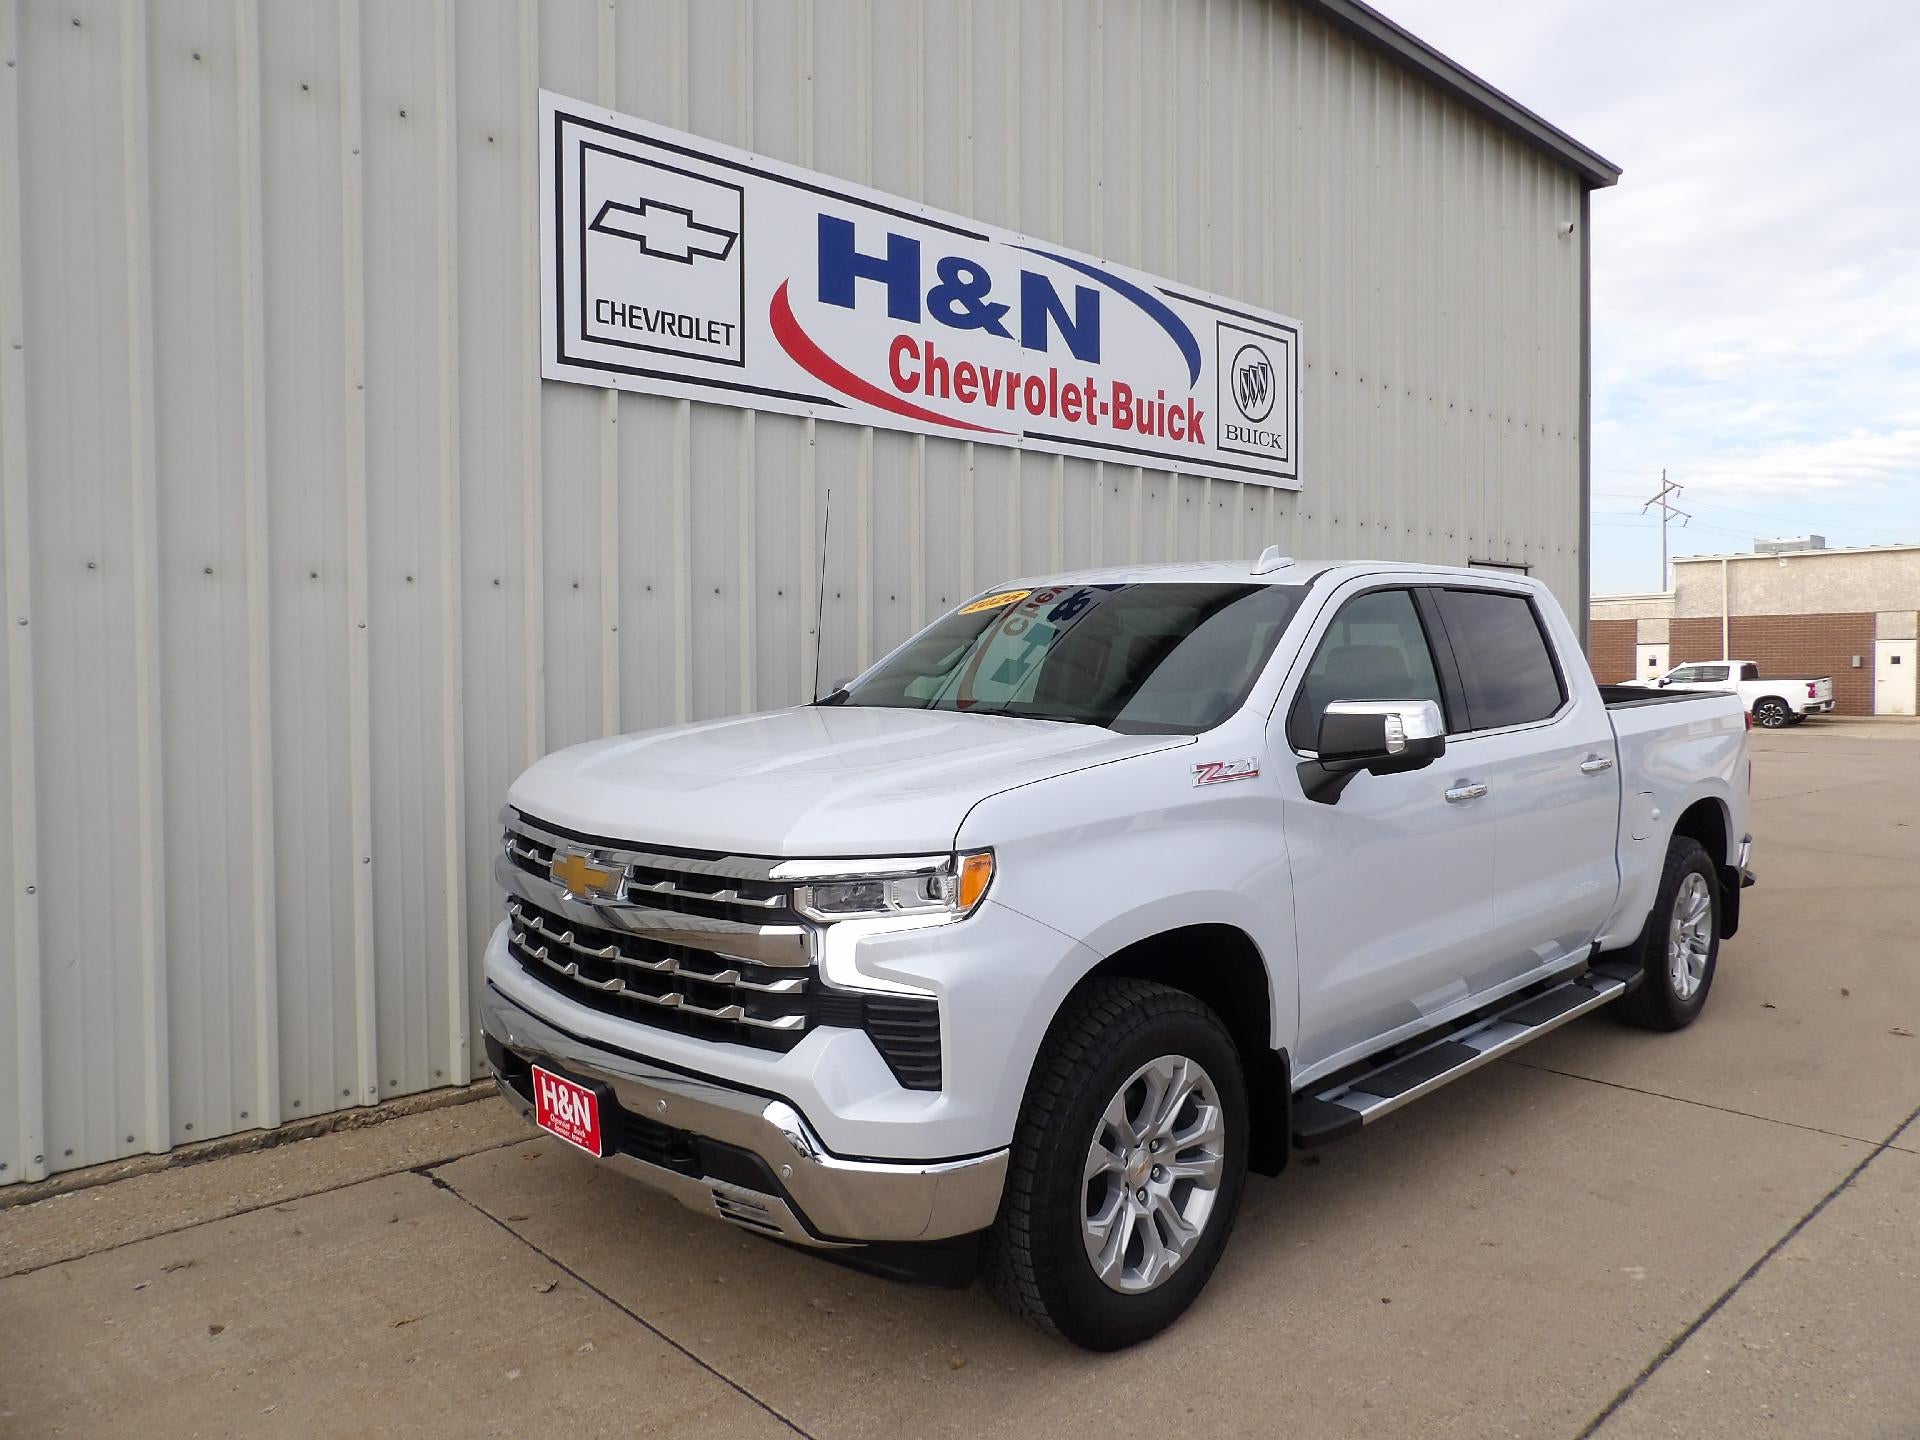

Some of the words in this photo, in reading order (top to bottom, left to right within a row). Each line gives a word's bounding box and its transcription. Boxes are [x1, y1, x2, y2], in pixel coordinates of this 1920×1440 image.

[817, 212, 1101, 364] H&N
[595, 298, 736, 347] CHEVROLET
[888, 334, 1206, 445] Chevrolet-Buick
[1224, 424, 1283, 451] BUICK
[541, 1076, 592, 1132] H&N
